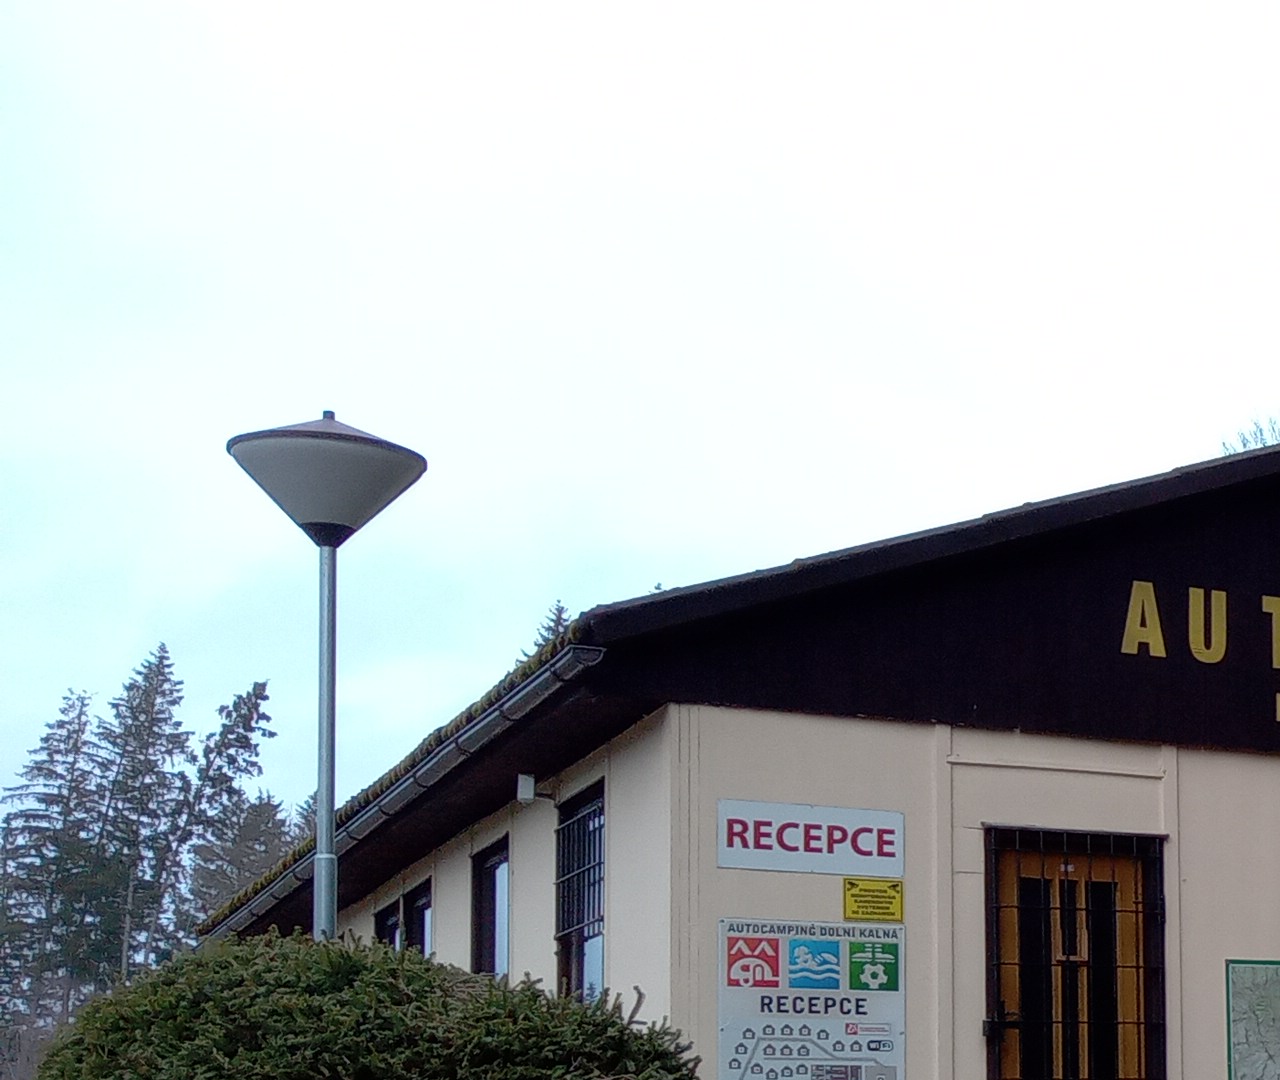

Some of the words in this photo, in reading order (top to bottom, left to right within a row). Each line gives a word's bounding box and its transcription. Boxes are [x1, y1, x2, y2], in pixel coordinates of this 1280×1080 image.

[726, 818, 897, 858] RECEPCE
[727, 923, 816, 937] AUTOCAMPING
[820, 926, 856, 938] DOLNÍ
[859, 927, 898, 939] KALNÁ
[760, 995, 868, 1016] RECEPCE
